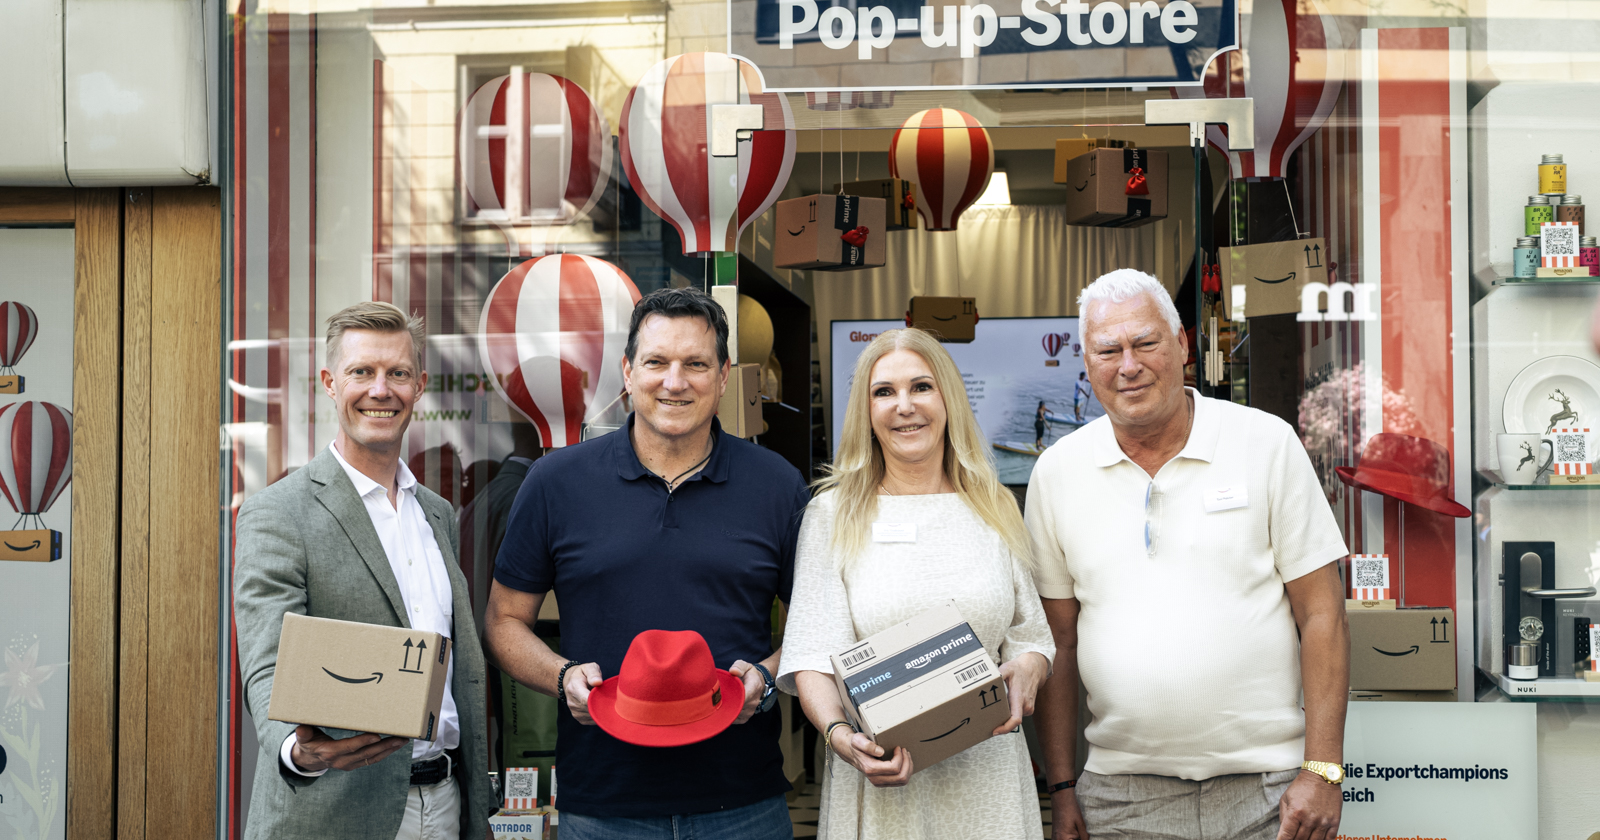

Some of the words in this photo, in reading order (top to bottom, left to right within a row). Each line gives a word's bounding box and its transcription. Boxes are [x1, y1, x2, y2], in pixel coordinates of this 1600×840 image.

[778, 0, 1198, 60] Pop-up-Store
[843, 198, 851, 223] prime
[905, 646, 941, 671] amazon
[941, 632, 973, 654] prime
[859, 670, 892, 693] prime
[510, 679, 519, 736] NORDLIGH
[1366, 764, 1509, 782] Exportchampions
